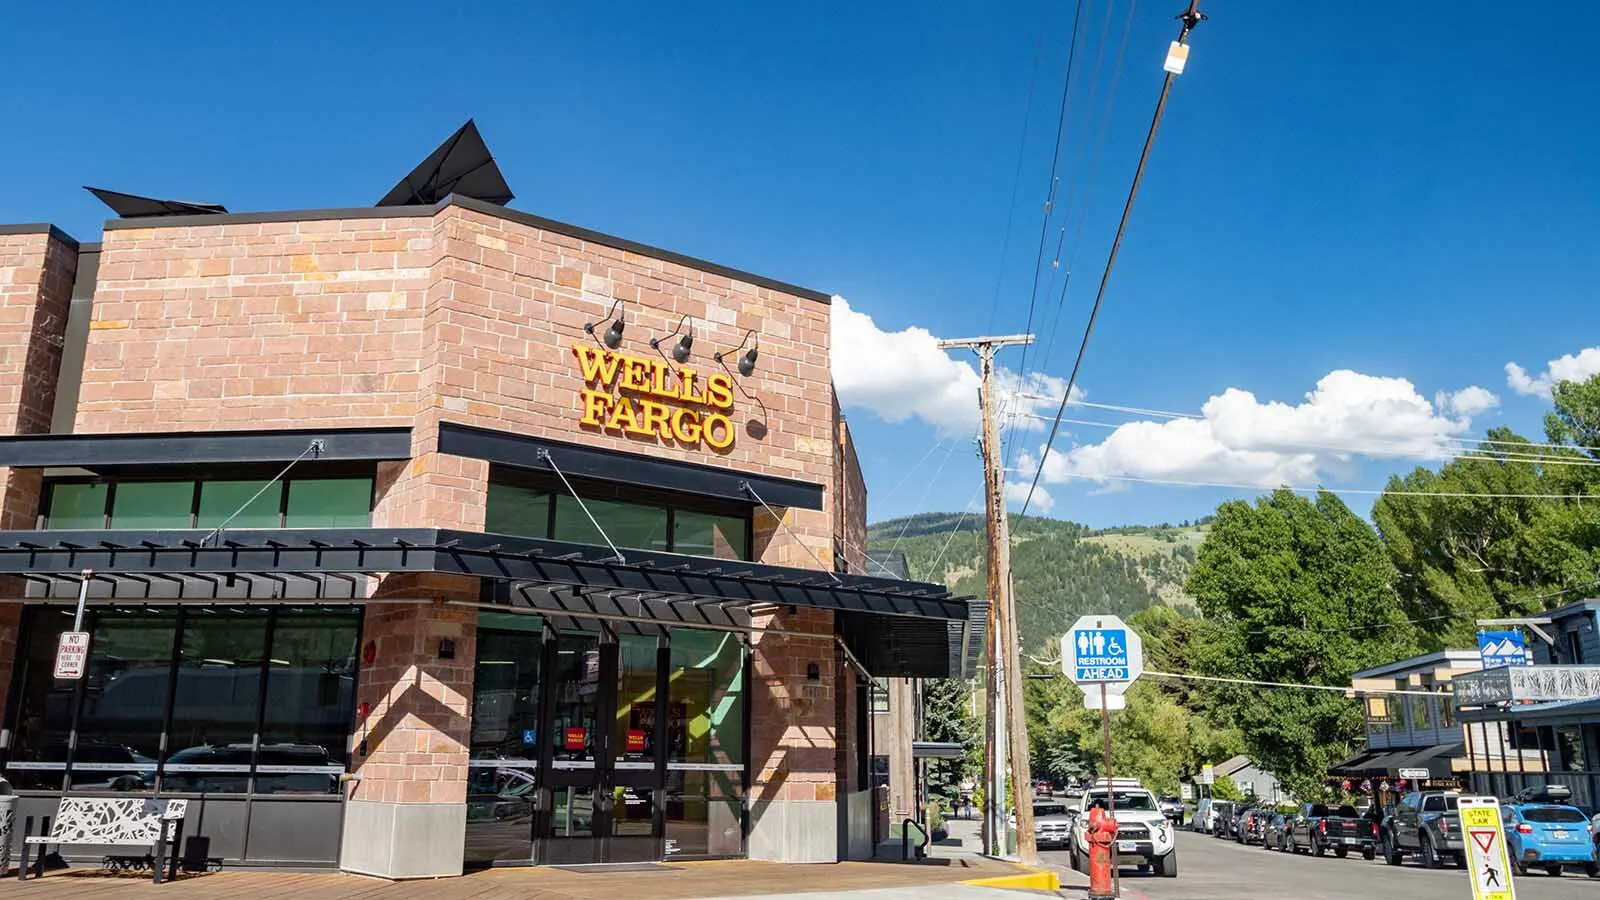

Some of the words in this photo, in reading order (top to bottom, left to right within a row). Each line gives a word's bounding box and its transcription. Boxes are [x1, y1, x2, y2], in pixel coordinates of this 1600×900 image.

[573, 344, 735, 409] WELLS
[579, 388, 735, 449] FARGO
[69, 635, 80, 644] NO
[61, 644, 85, 654] PARKING
[1078, 657, 1126, 666] RESTROOM
[1082, 668, 1123, 679] AHEAD
